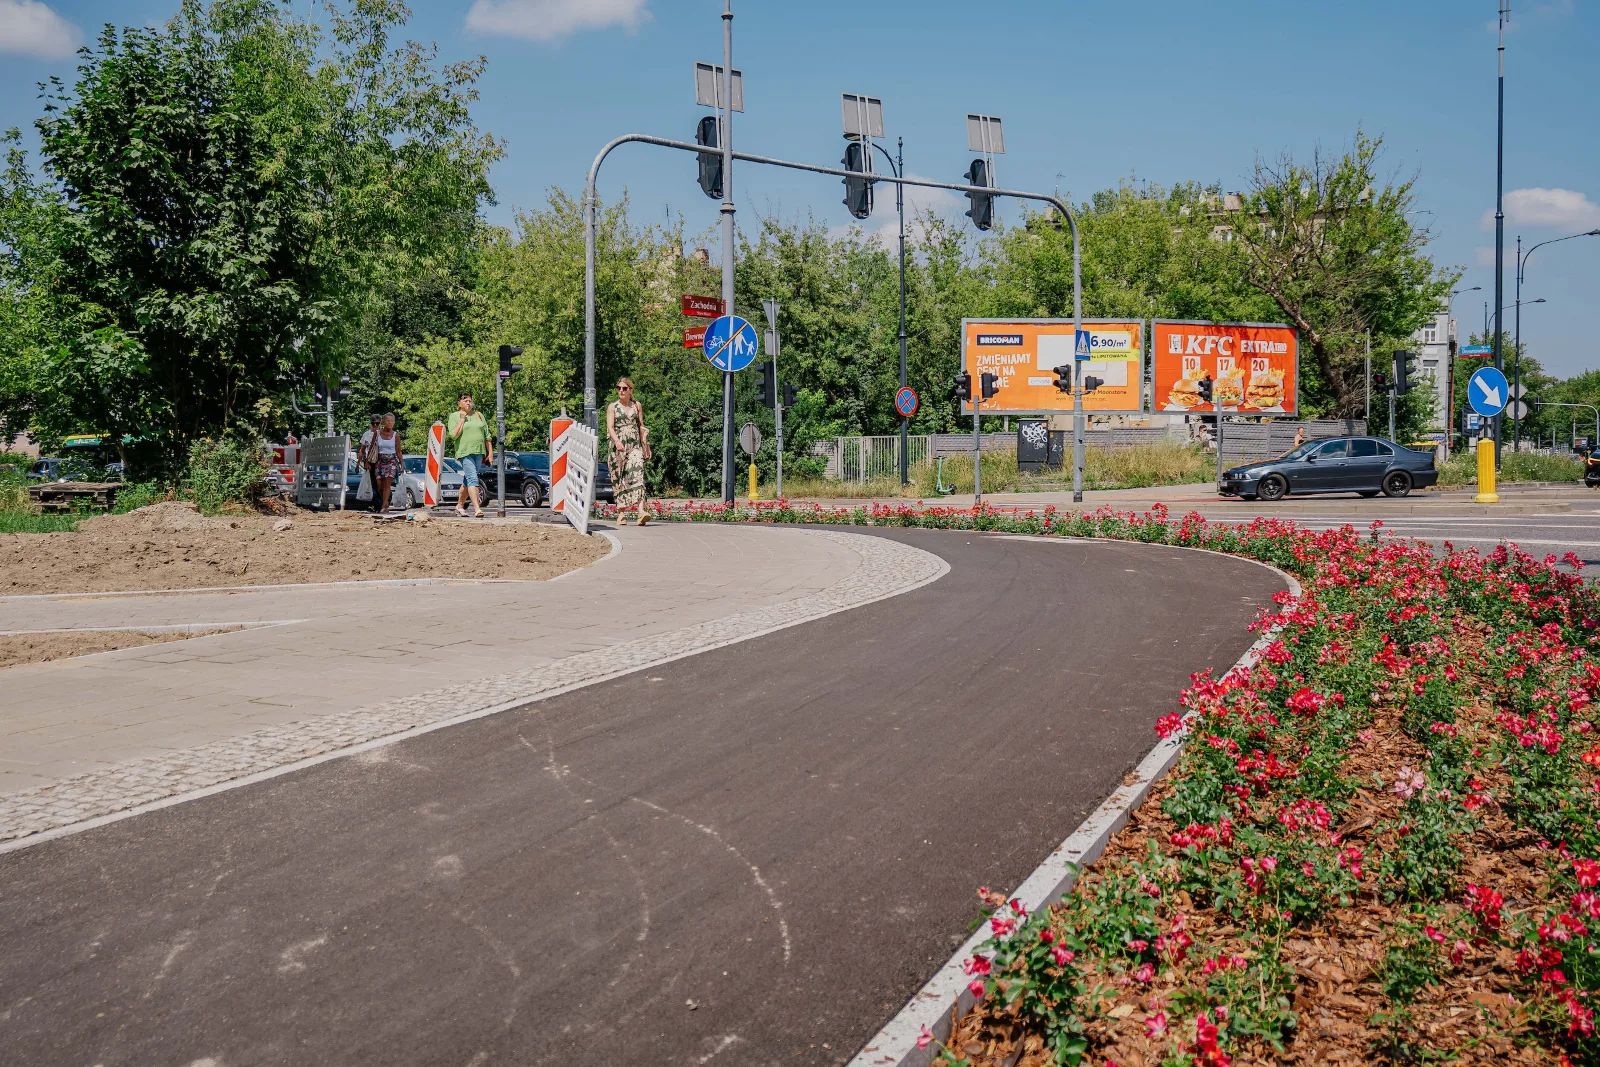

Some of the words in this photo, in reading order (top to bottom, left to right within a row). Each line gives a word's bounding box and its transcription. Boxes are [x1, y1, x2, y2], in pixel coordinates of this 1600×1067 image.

[690, 300, 717, 311] Zachodnia
[685, 333, 705, 341] Drewno
[979, 336, 1020, 344] BRICOMAN
[1185, 335, 1232, 355] KFC
[1241, 340, 1275, 353] EXTRA
[976, 353, 1031, 366] ZMIENIAMY
[1184, 358, 1196, 370] 10
[1220, 359, 1230, 370] 17
[1003, 366, 1016, 376] NA
[1252, 360, 1265, 371] 20
